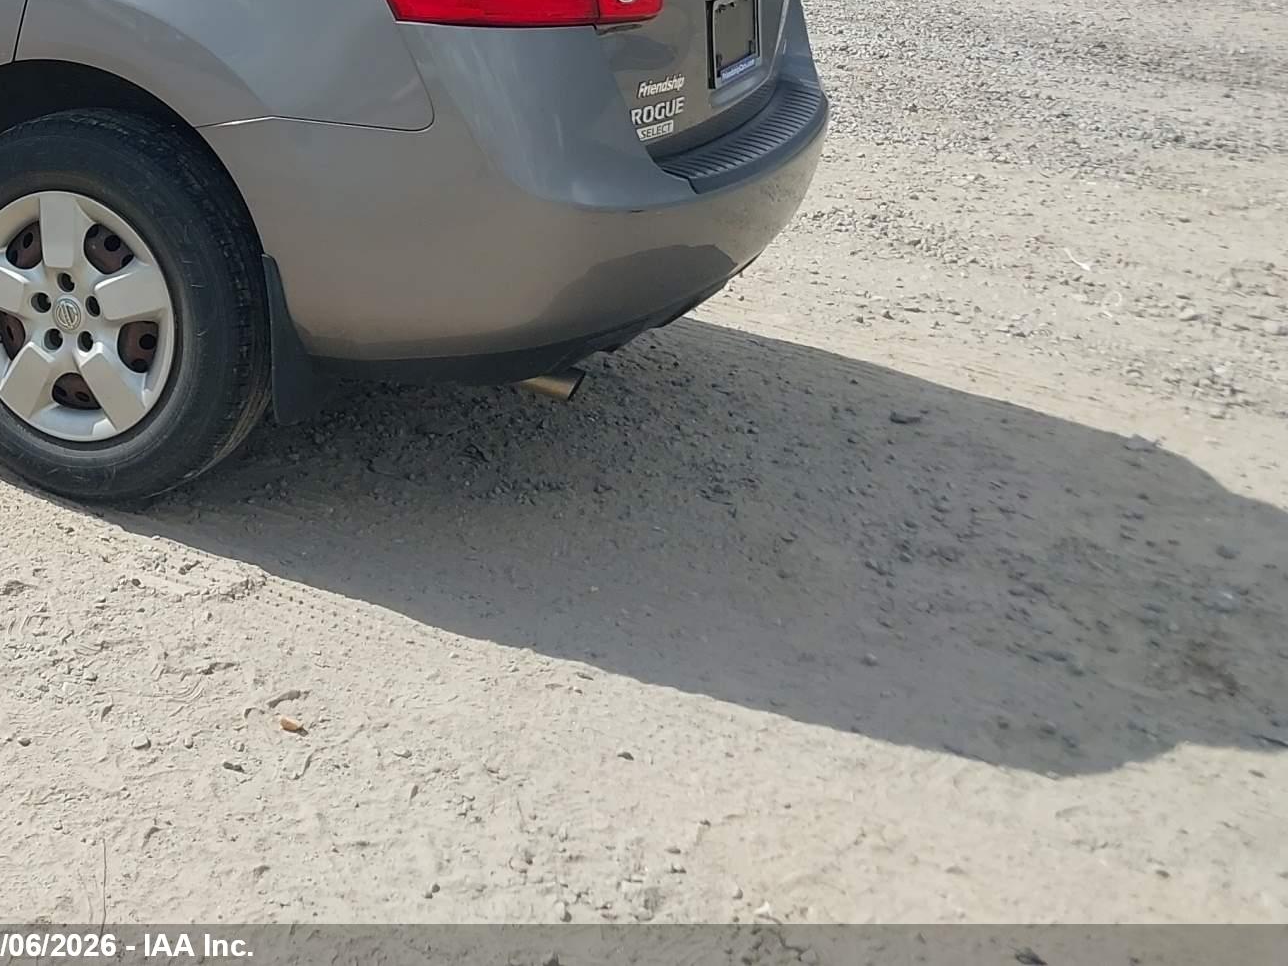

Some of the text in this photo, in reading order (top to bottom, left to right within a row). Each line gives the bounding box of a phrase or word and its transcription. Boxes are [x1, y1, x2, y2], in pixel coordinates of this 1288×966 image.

[637, 74, 685, 98] Friendship
[631, 96, 685, 126] ROGUE
[640, 122, 673, 139] SELECT
